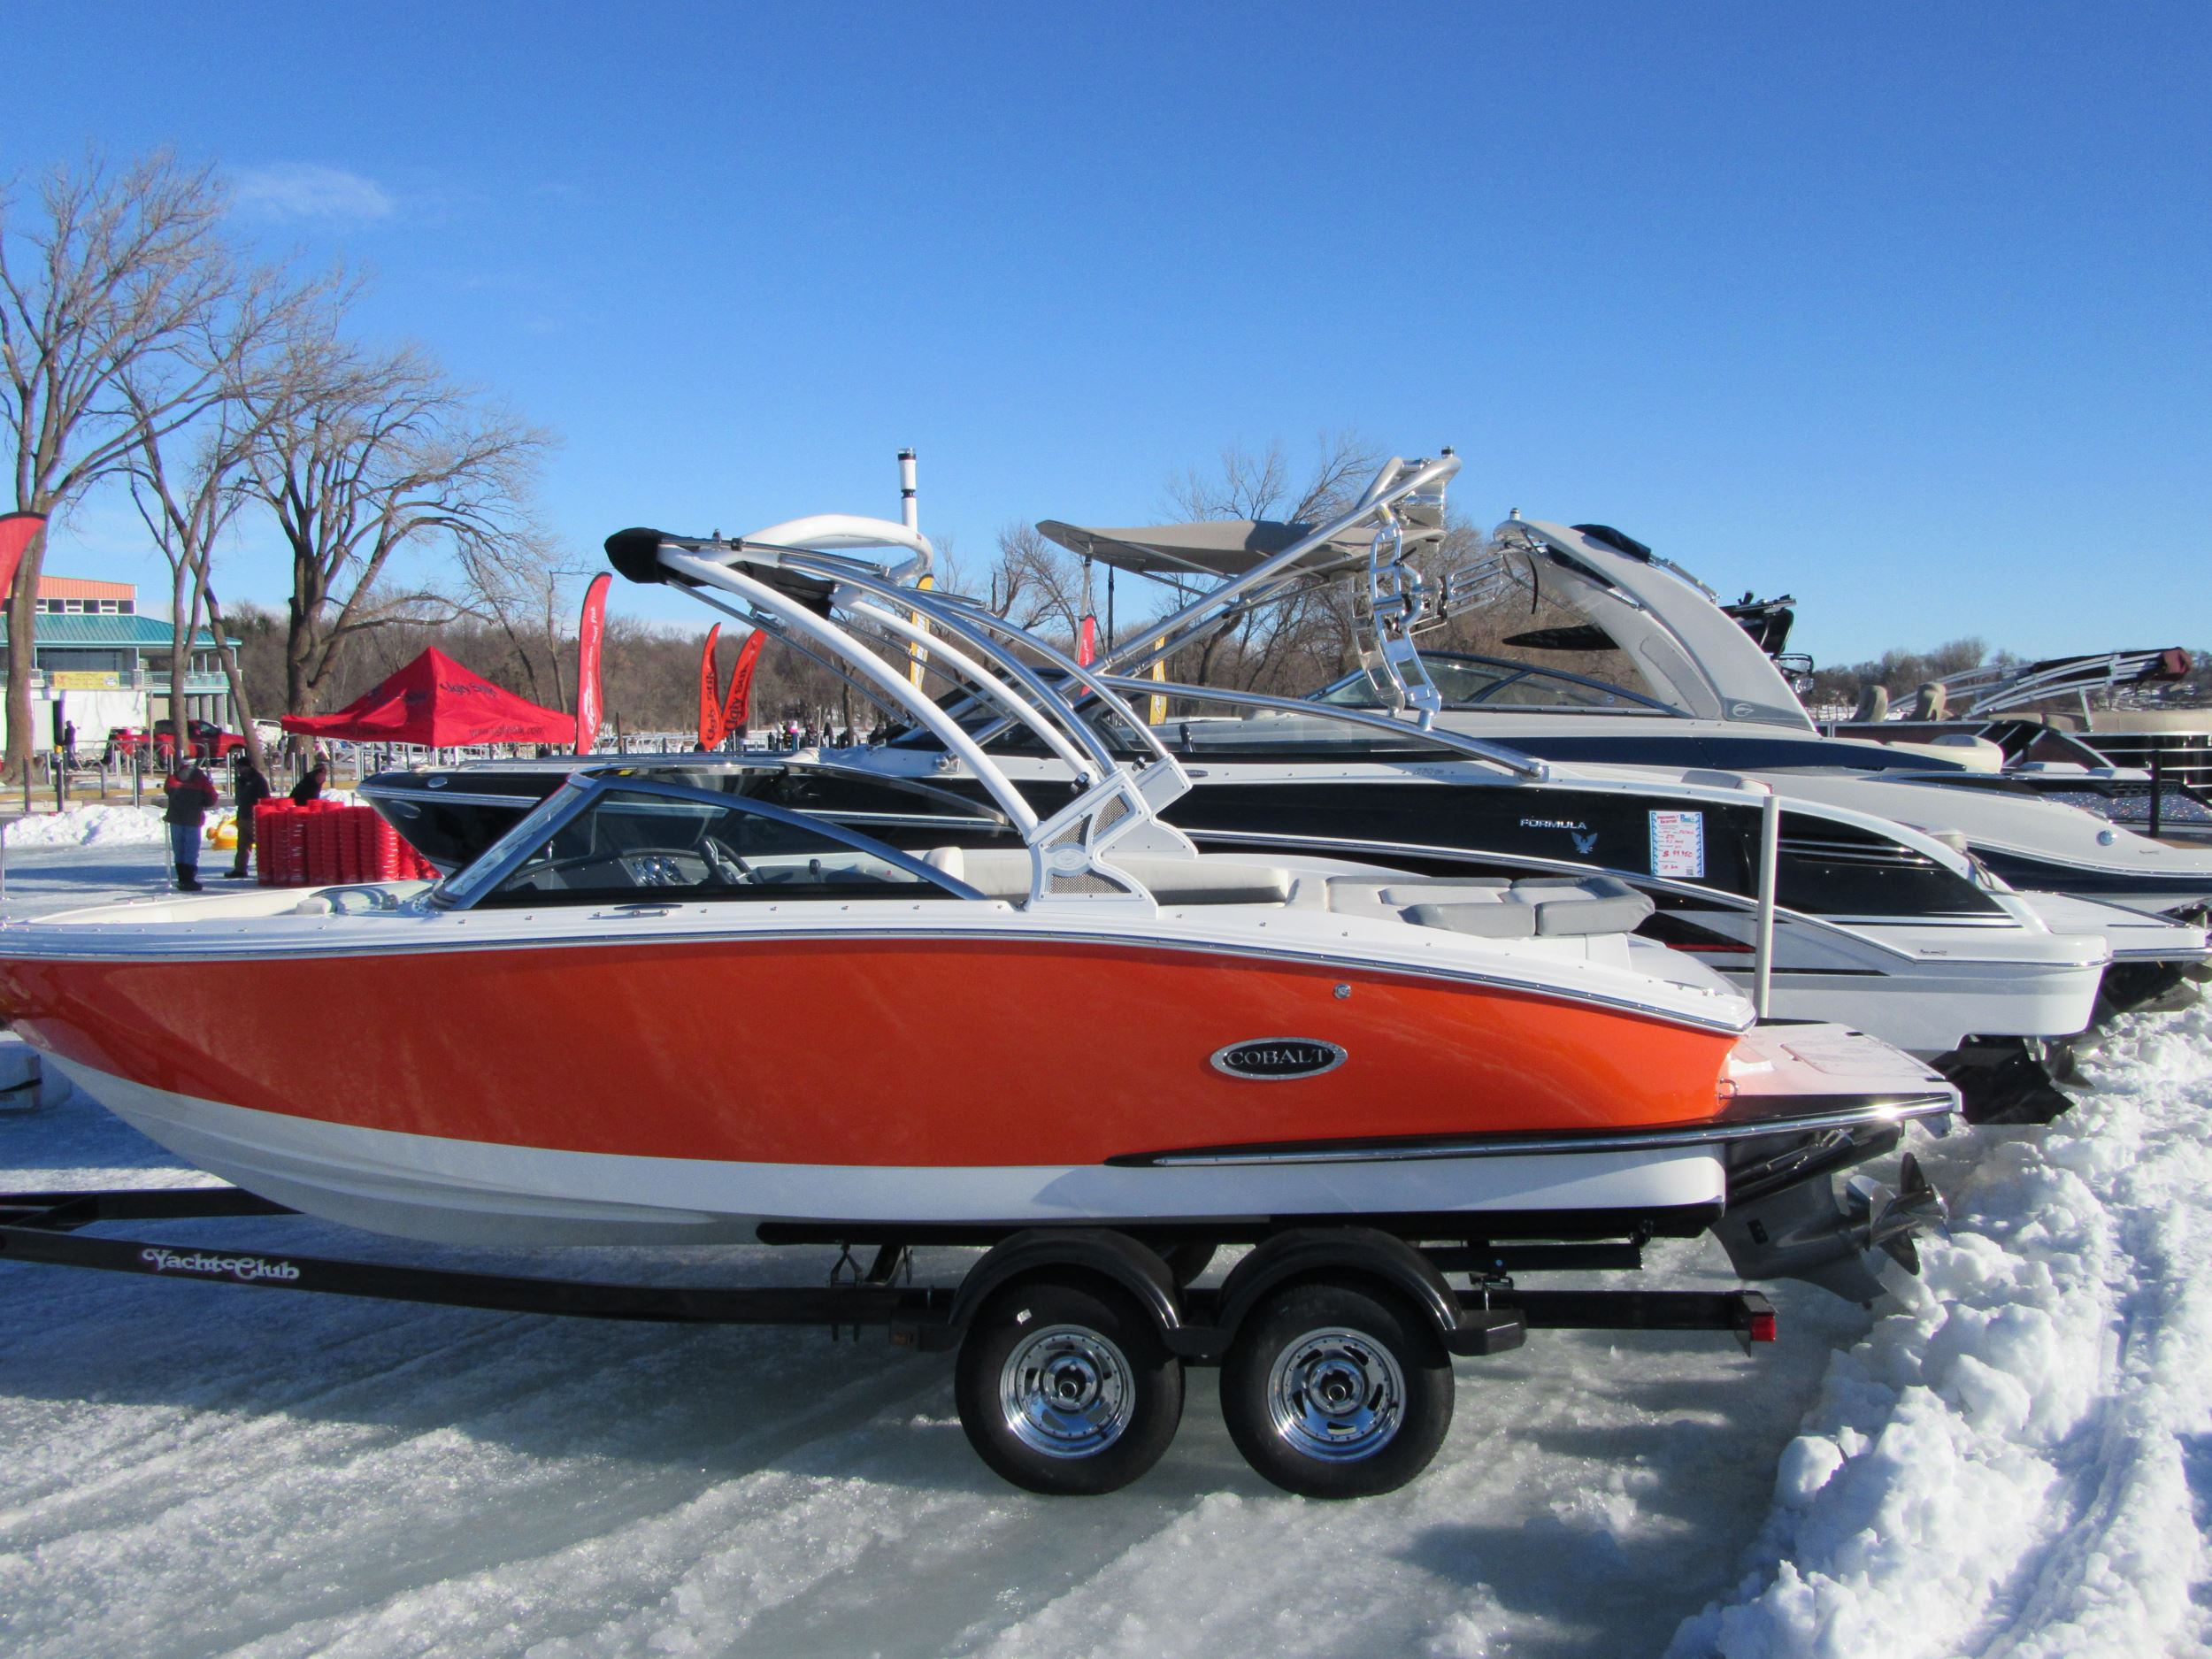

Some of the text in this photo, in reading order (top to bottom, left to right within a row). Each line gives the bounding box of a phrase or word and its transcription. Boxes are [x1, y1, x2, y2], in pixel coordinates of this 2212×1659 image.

[439, 682, 471, 695] Ugly
[724, 697, 744, 732] Ugly
[1519, 818, 1586, 830] FORMULA
[1227, 1048, 1330, 1065] COBALT
